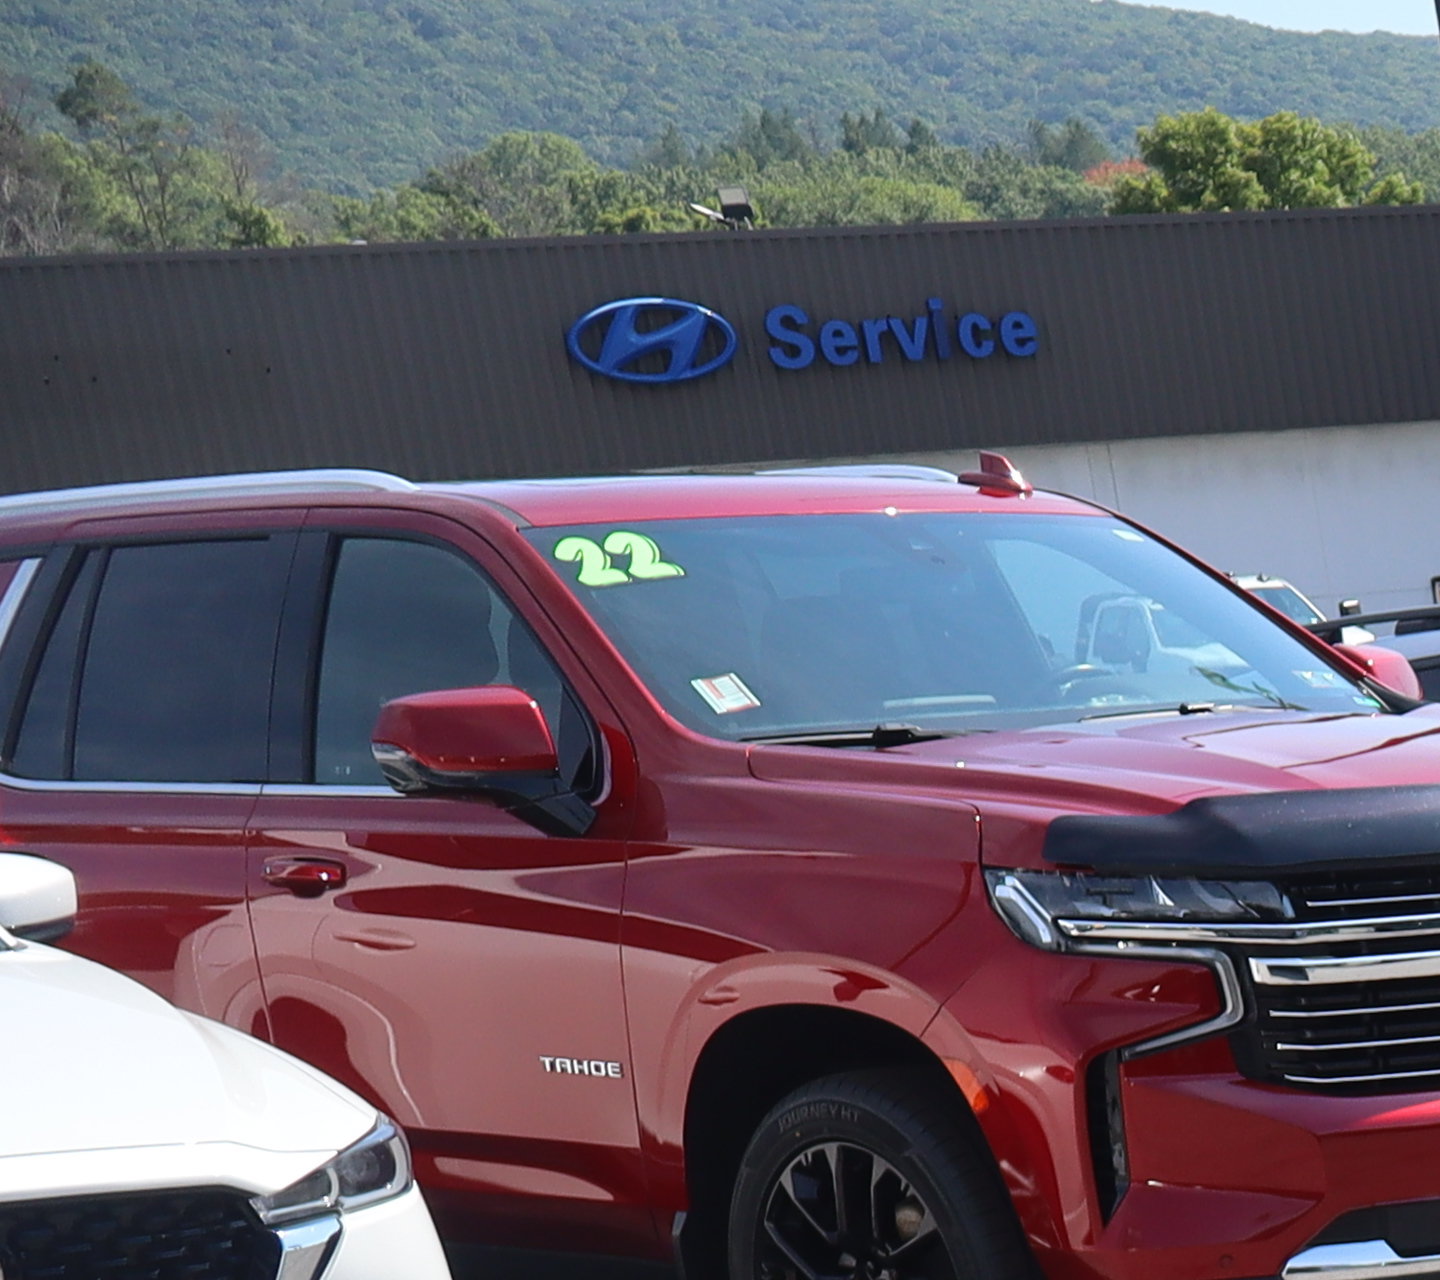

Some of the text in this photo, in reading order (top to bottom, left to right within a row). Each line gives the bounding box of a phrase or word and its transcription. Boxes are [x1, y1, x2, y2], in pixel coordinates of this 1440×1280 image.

[763, 298, 1039, 371] Service
[554, 531, 687, 587] 22
[539, 1055, 624, 1079] TAHOE
[778, 1102, 859, 1134] JOURNEY HT
